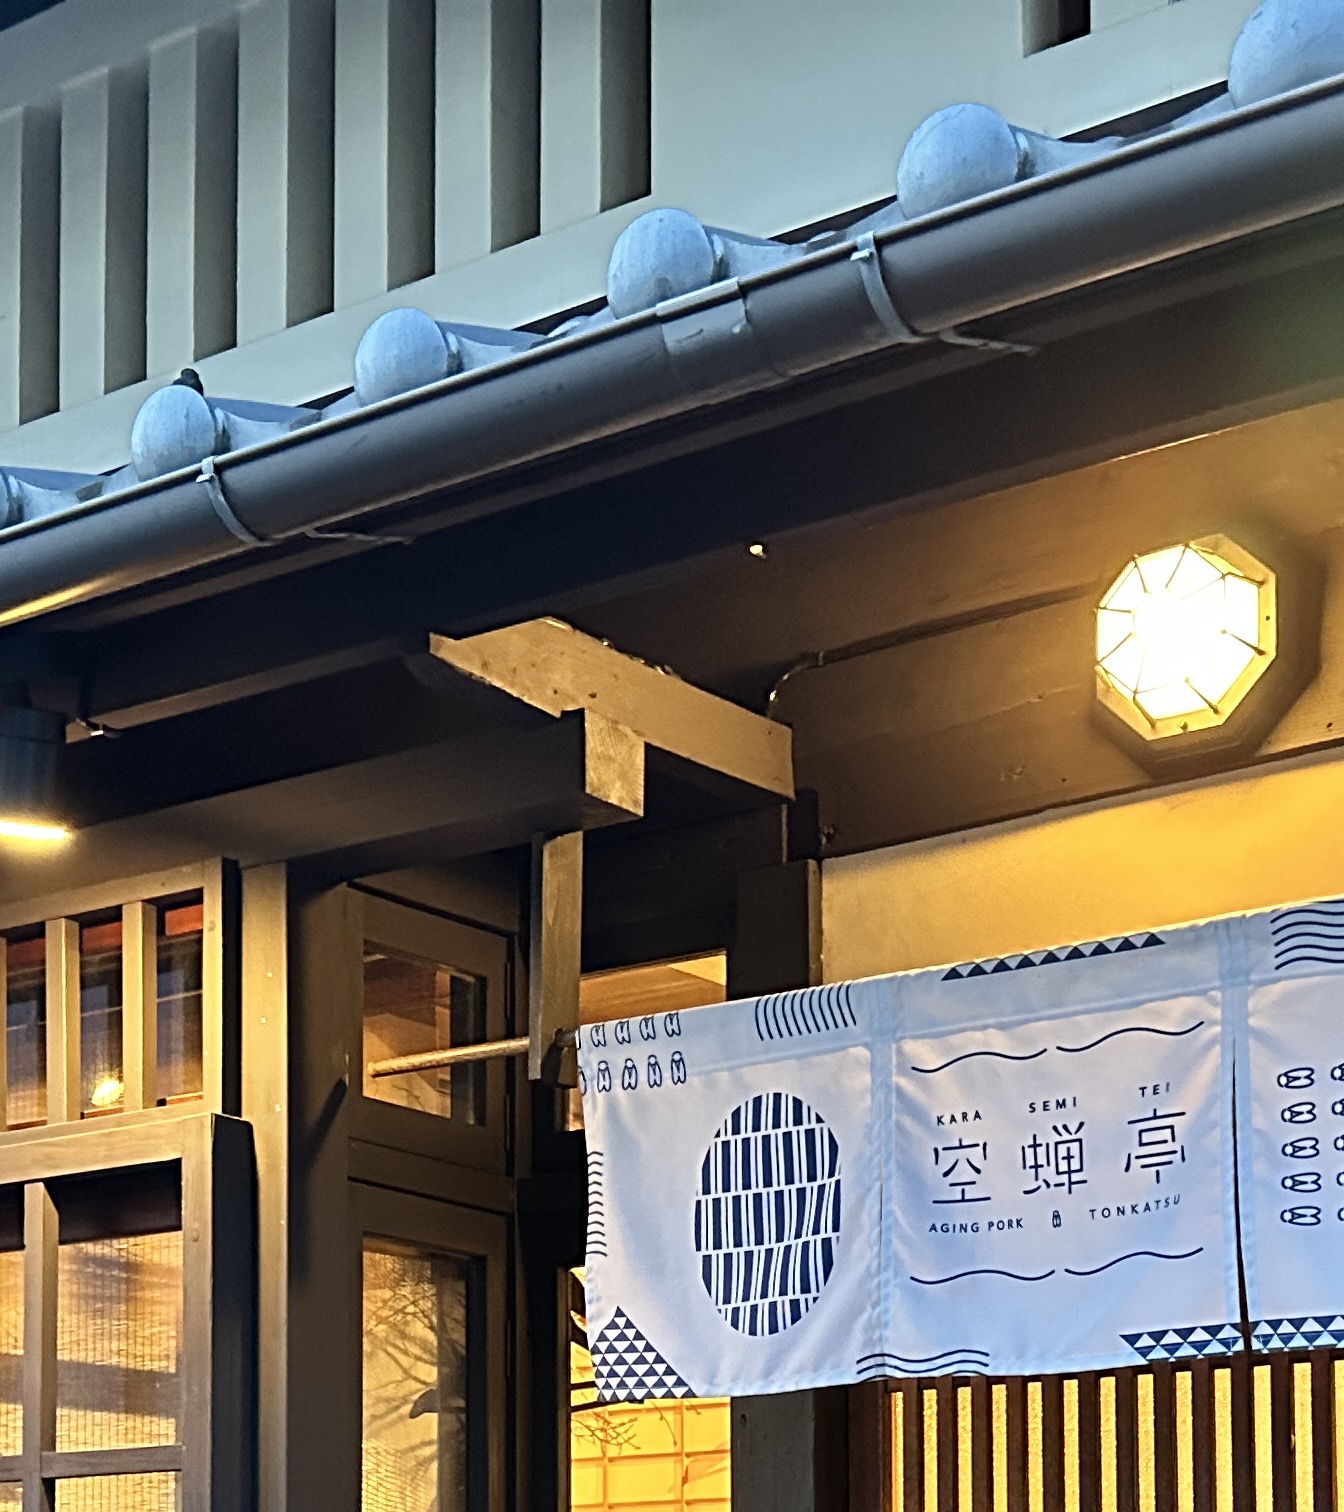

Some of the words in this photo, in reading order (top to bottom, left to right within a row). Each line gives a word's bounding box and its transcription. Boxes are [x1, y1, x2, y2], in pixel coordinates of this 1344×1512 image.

[936, 1109, 983, 1126] KARA
[1028, 1096, 1078, 1113] SEMI
[1138, 1082, 1171, 1098] TEI
[932, 1108, 1187, 1204] 空蝉亭
[928, 1222, 981, 1234] AGING
[987, 1217, 1024, 1232] PORK
[1088, 1193, 1182, 1220] TONKATSU
